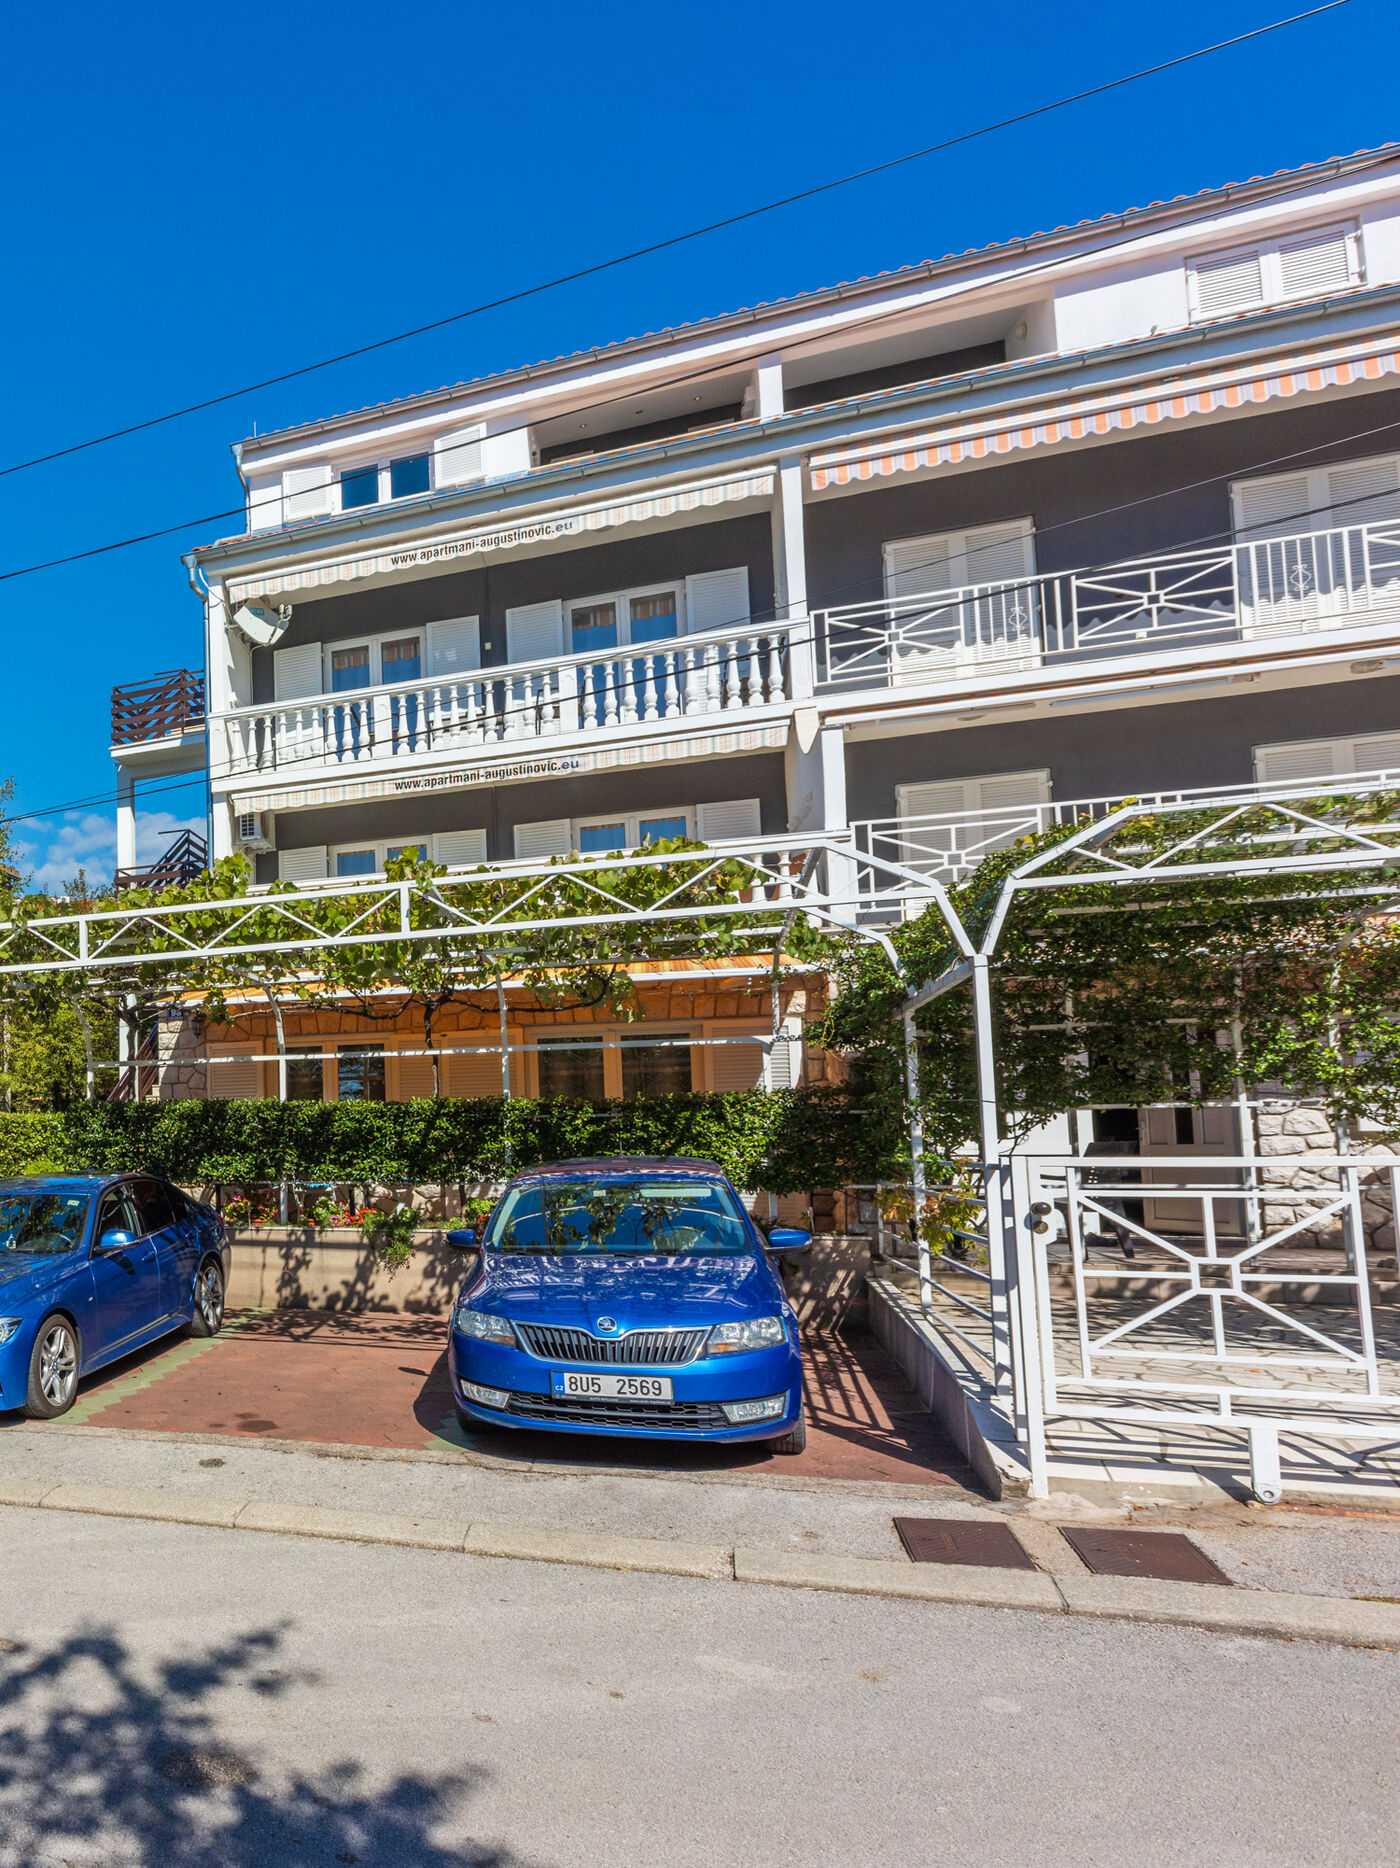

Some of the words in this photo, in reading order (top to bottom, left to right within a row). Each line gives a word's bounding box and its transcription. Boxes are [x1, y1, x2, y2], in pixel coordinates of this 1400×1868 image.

[394, 759, 580, 791] www.apartmani-augustinovic.eu
[568, 1376, 601, 1393] 8U5
[616, 1378, 662, 1396] 2569
